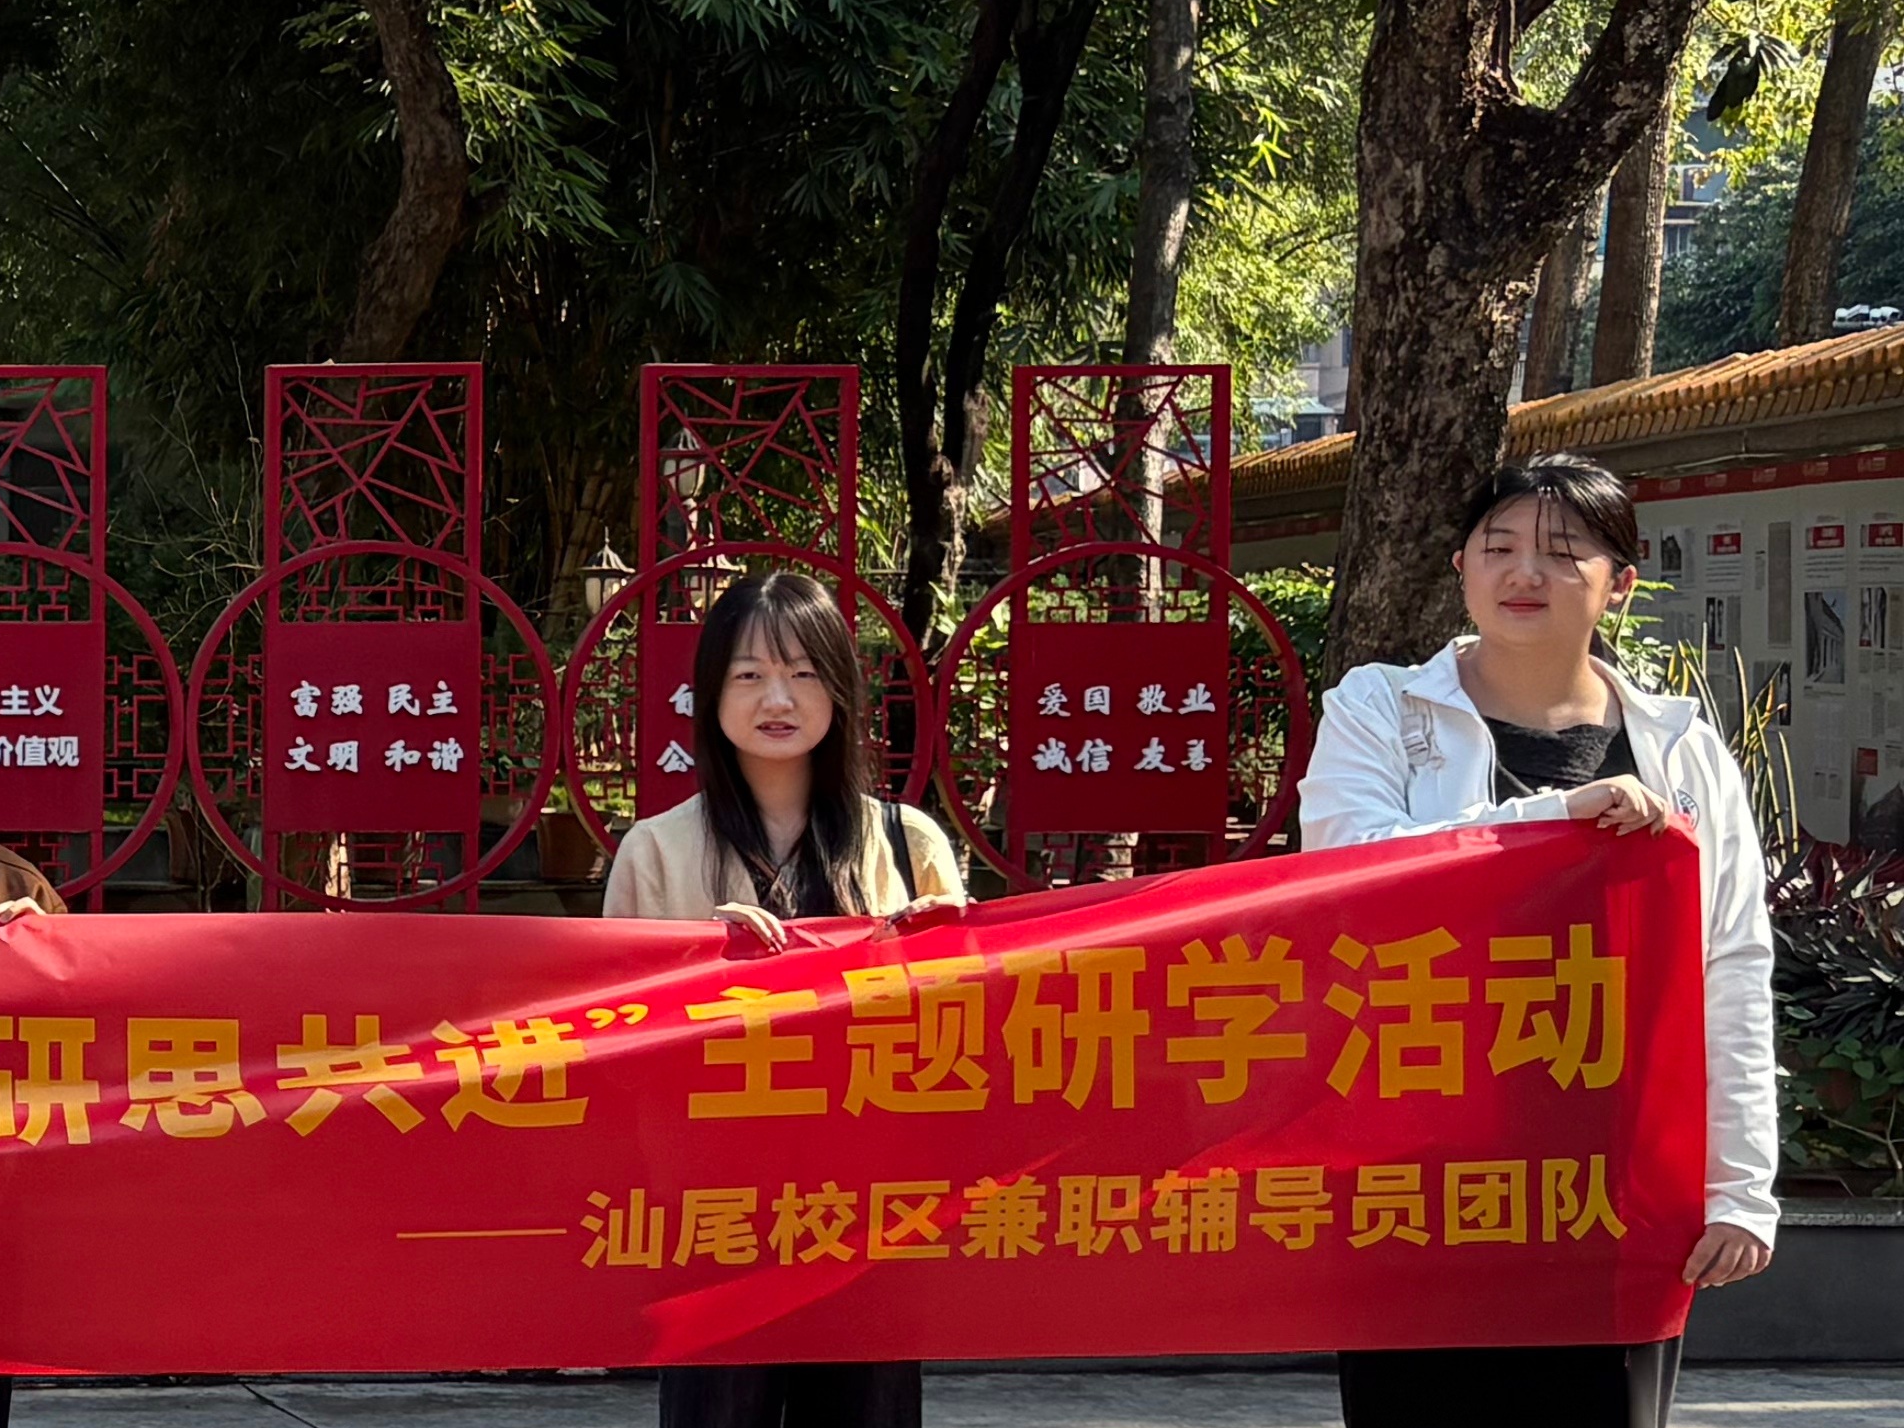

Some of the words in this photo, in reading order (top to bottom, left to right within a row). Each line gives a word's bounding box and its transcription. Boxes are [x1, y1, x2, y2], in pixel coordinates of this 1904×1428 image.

[290, 680, 363, 717] 富强
[387, 680, 458, 716] 民主
[668, 683, 694, 717] 自
[1037, 682, 1111, 717] 爱国
[1136, 683, 1216, 715] 敬业
[284, 736, 359, 773] 文明
[384, 737, 464, 773] 和谐
[656, 739, 695, 773] 公
[1031, 737, 1113, 774] 诚信
[1133, 737, 1212, 772] 友善
